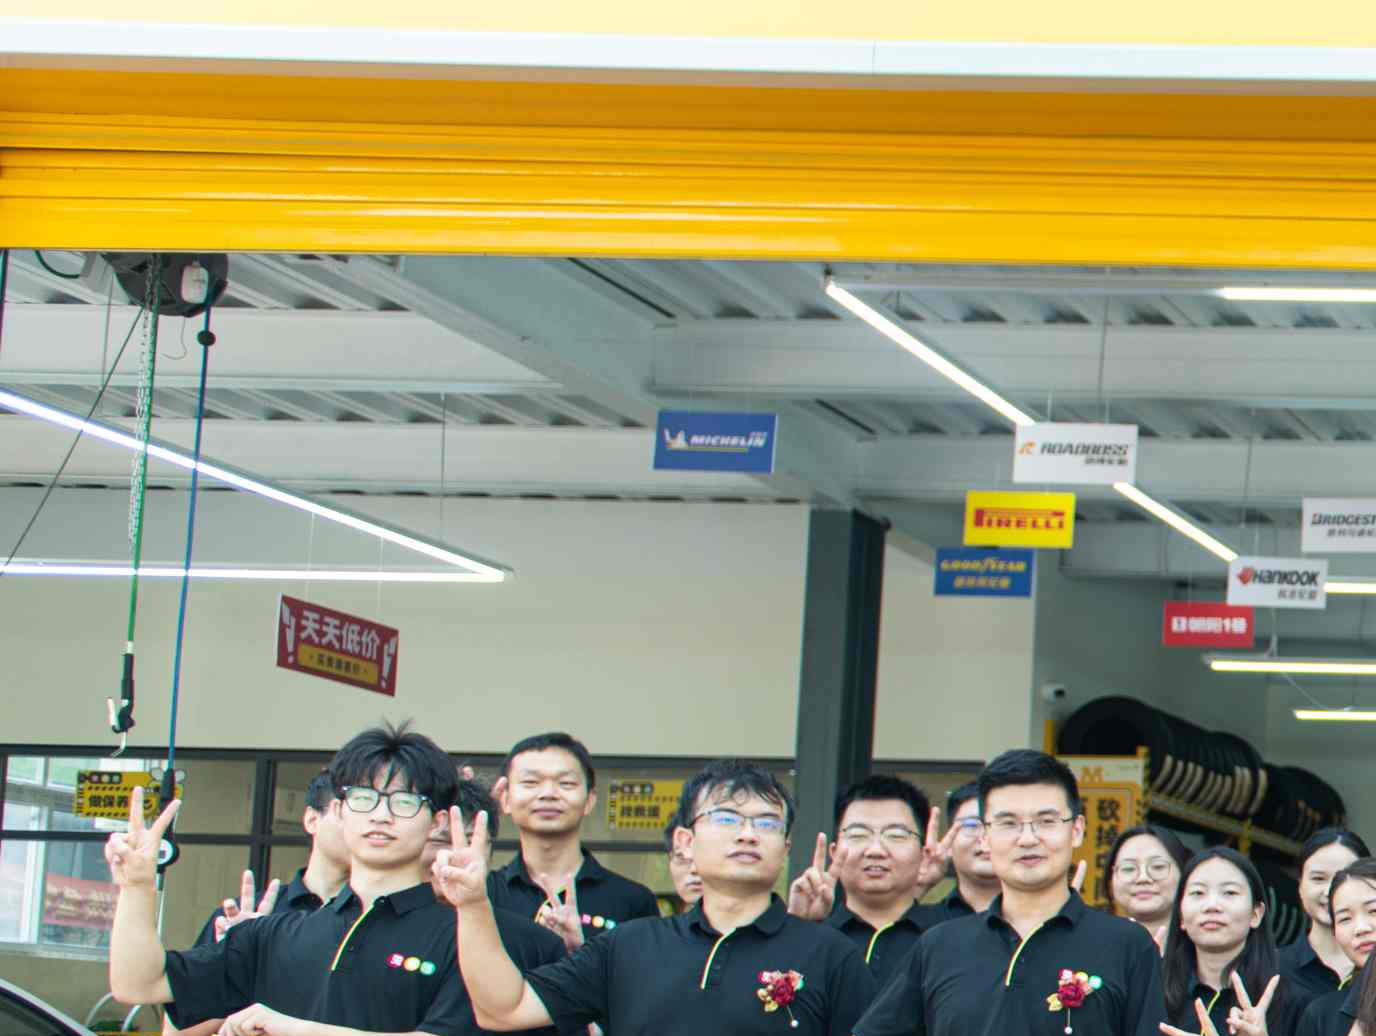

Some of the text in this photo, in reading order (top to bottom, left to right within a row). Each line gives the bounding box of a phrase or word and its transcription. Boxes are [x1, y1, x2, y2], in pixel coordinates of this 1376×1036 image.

[690, 434, 767, 448] MICHELIN
[973, 508, 1065, 529] PIRELLI
[300, 610, 380, 660] 天天低价
